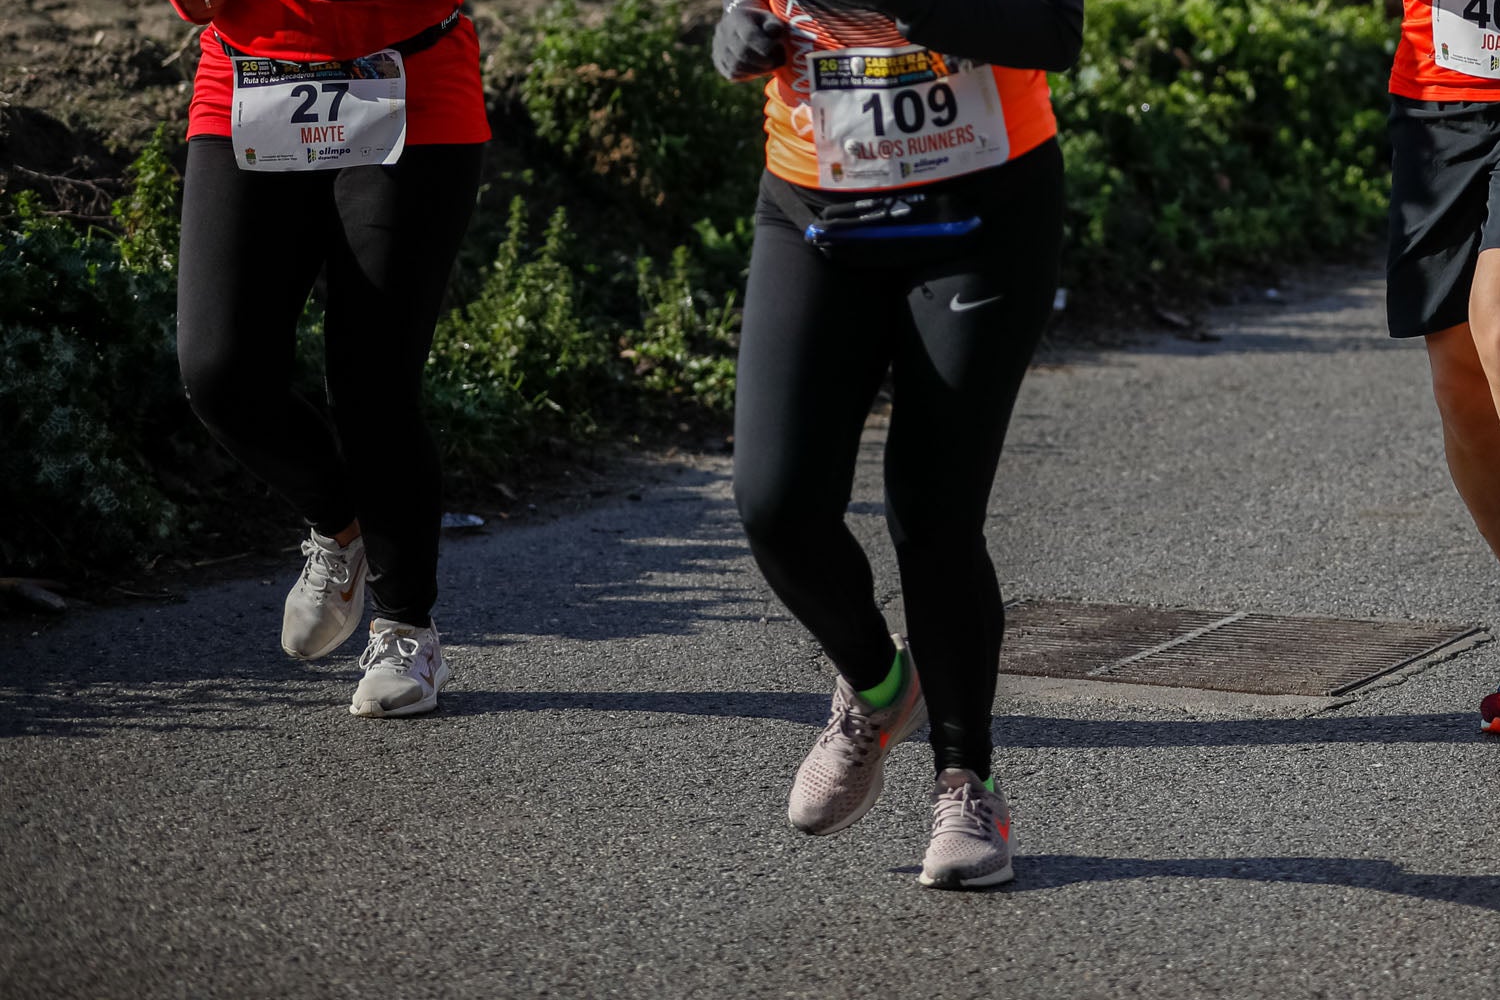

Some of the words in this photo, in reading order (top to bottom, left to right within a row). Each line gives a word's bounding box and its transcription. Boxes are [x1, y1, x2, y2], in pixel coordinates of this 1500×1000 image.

[242, 61, 258, 71] 26
[819, 59, 838, 72] 26
[865, 52, 930, 67] CARRERA
[865, 62, 929, 77] POPULAR
[243, 77, 259, 85] Ruta
[290, 82, 350, 124] 27
[862, 82, 958, 137] 109
[301, 125, 345, 144] MAYTE
[906, 124, 975, 157] RUNNERS
[319, 147, 351, 156] olimpo
